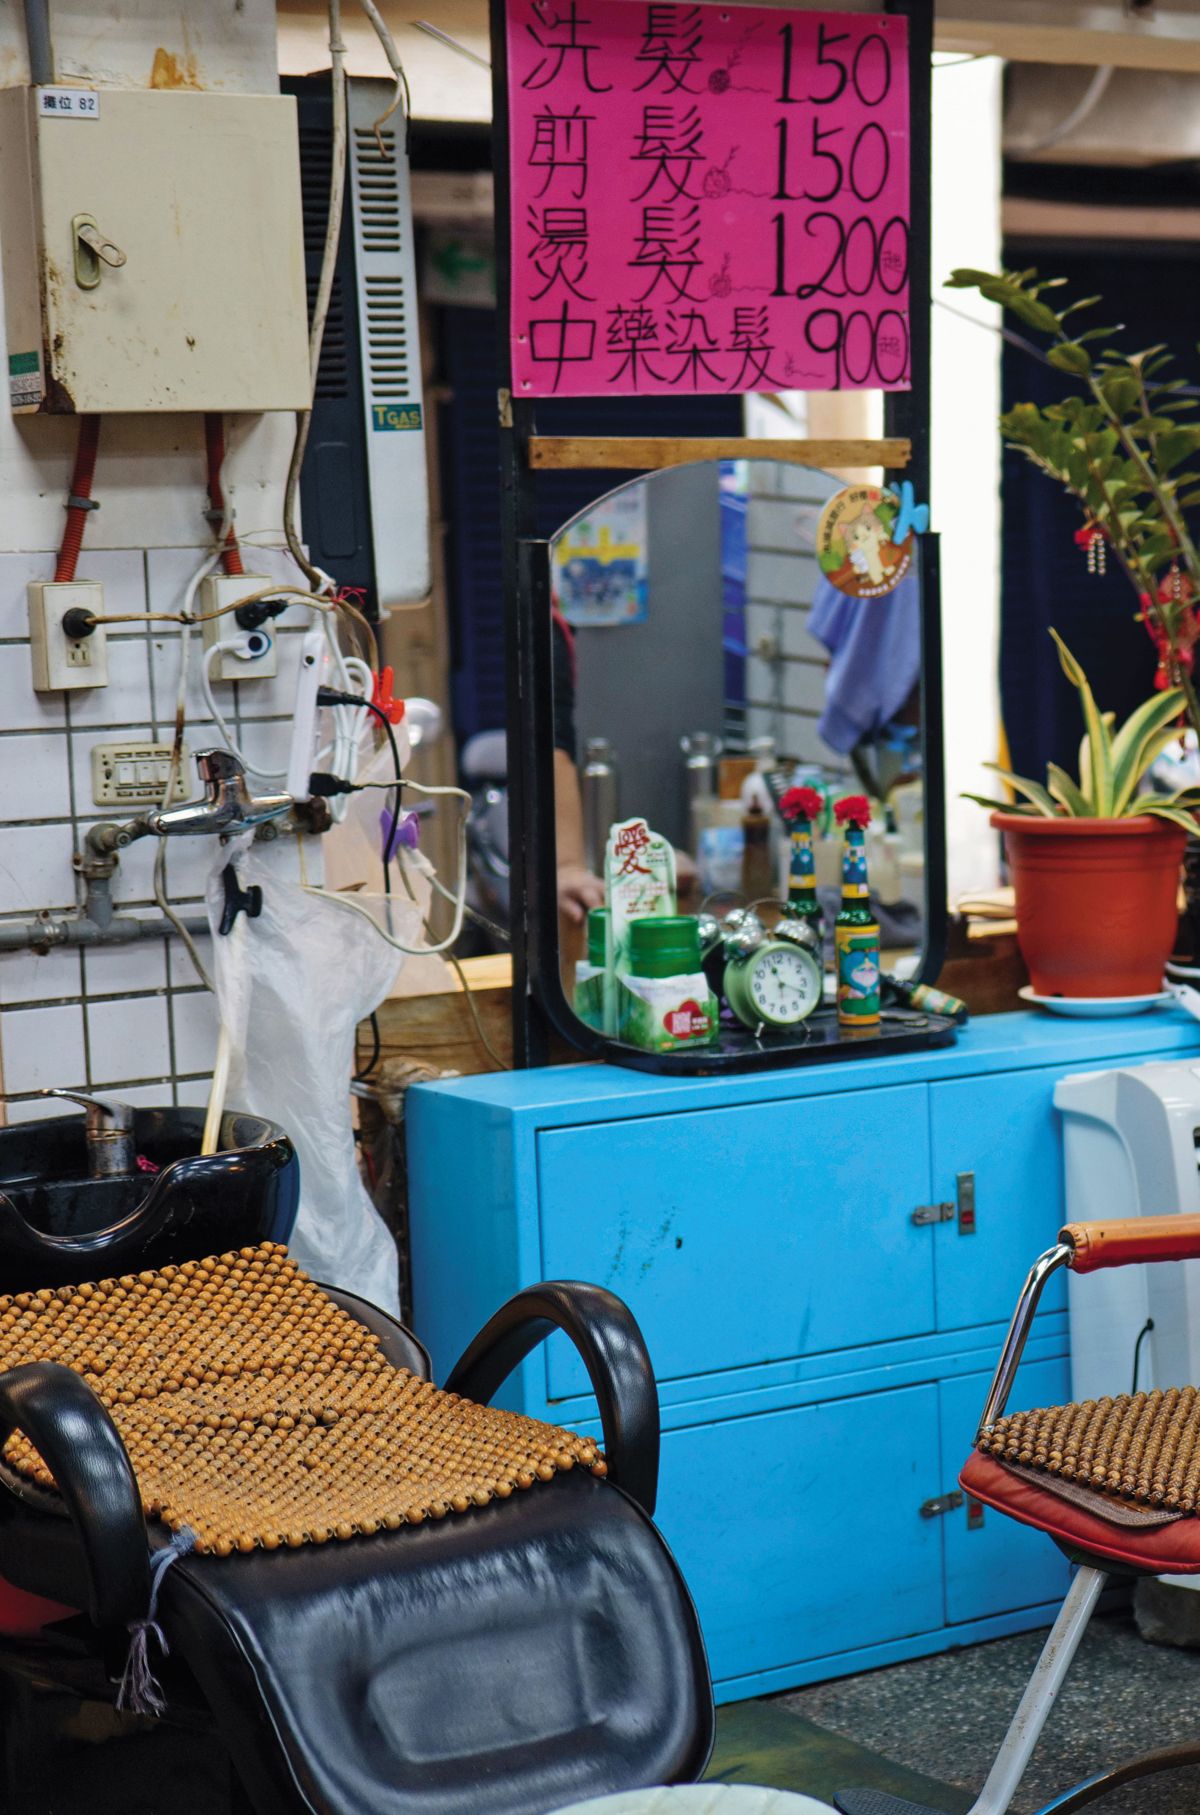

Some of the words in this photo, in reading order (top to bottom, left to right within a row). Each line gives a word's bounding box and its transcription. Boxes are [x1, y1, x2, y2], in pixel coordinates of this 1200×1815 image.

[43, 95, 73, 110] 攤位
[79, 98, 95, 110] 82
[775, 23, 892, 106] 150
[770, 117, 890, 202] 150
[769, 212, 909, 300] 1200
[804, 308, 910, 390] 900
